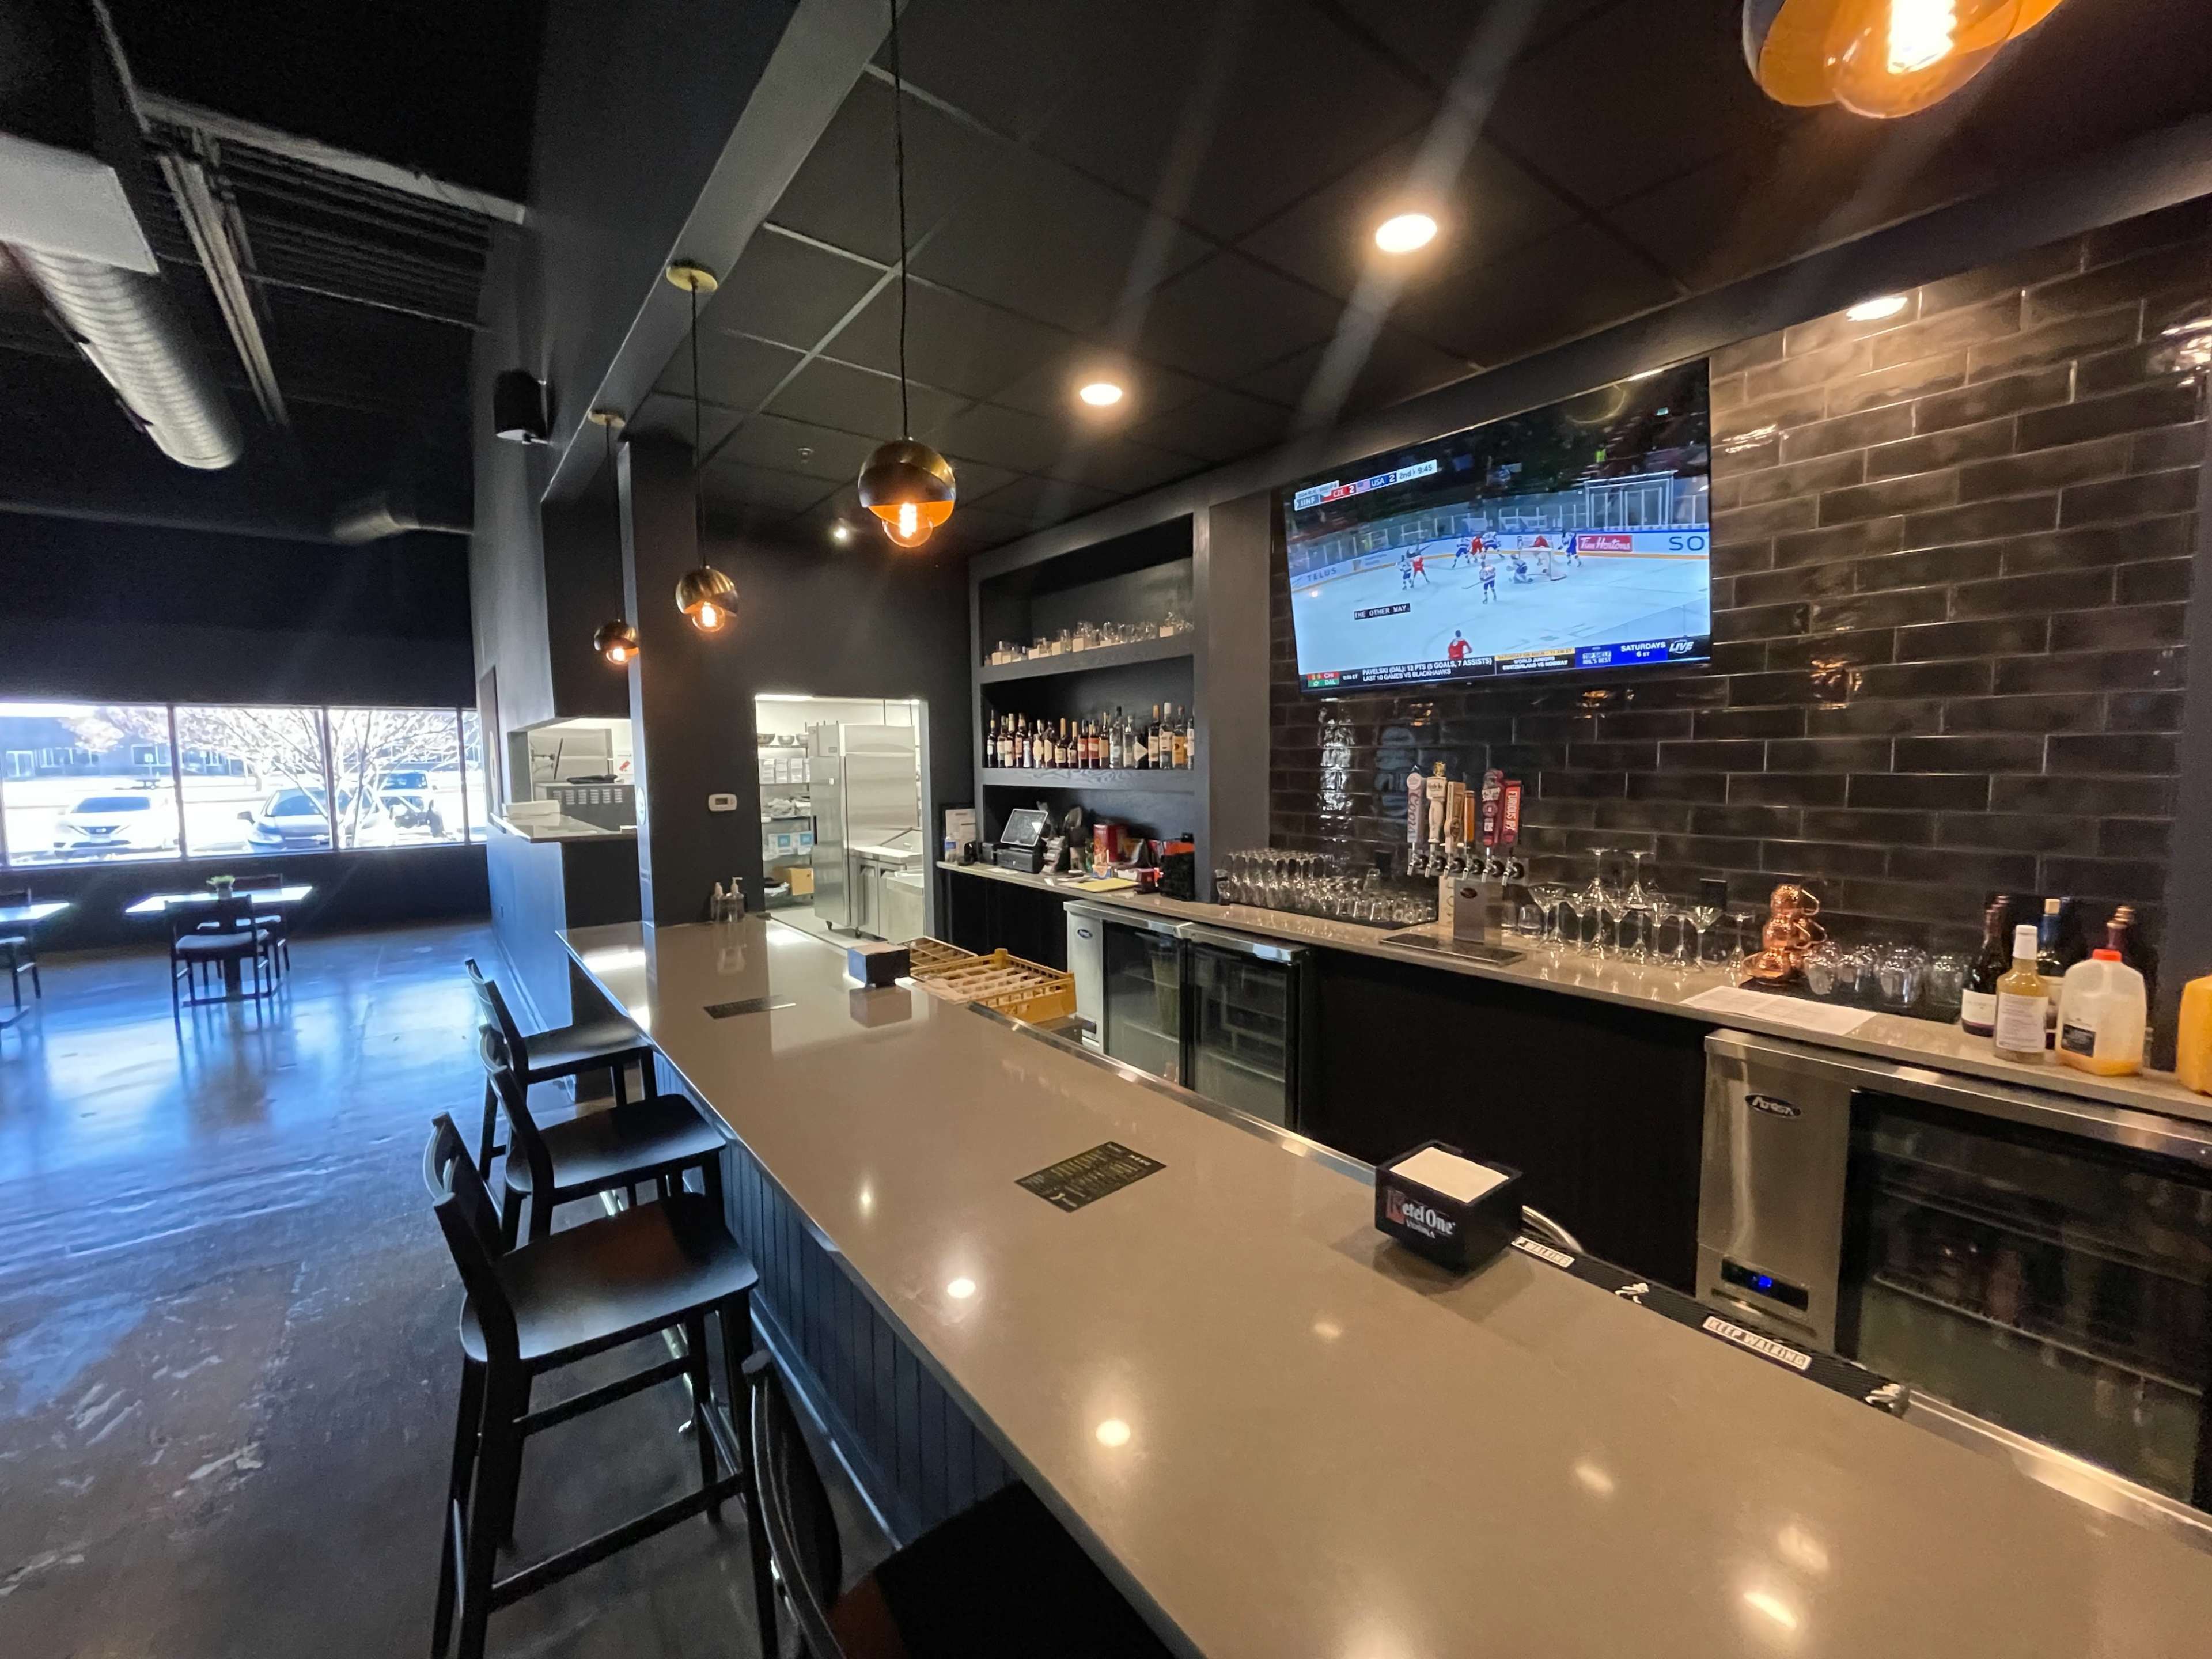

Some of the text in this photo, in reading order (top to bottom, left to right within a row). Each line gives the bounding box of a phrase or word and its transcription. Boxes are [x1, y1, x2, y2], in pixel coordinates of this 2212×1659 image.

[1333, 488, 1345, 497] CZE
[1349, 485, 1355, 493] 2
[1399, 471, 1411, 479] 2nd
[1418, 465, 1433, 474] 9:45
[1581, 537, 1631, 550] Tim Hortons
[1307, 566, 1337, 582] TELUS
[1620, 641, 1666, 652] SATURDAYS
[1669, 640, 1695, 653] LIVE
[1433, 661, 1457, 669] GOALS,
[1463, 657, 1493, 666] ASSISTS)
[1412, 669, 1452, 677] BLACKHAWKS
[1425, 1209, 1454, 1236] One
[1524, 1241, 1569, 1264] WALKING
[1709, 1319, 1806, 1367] KEEP WALKING
